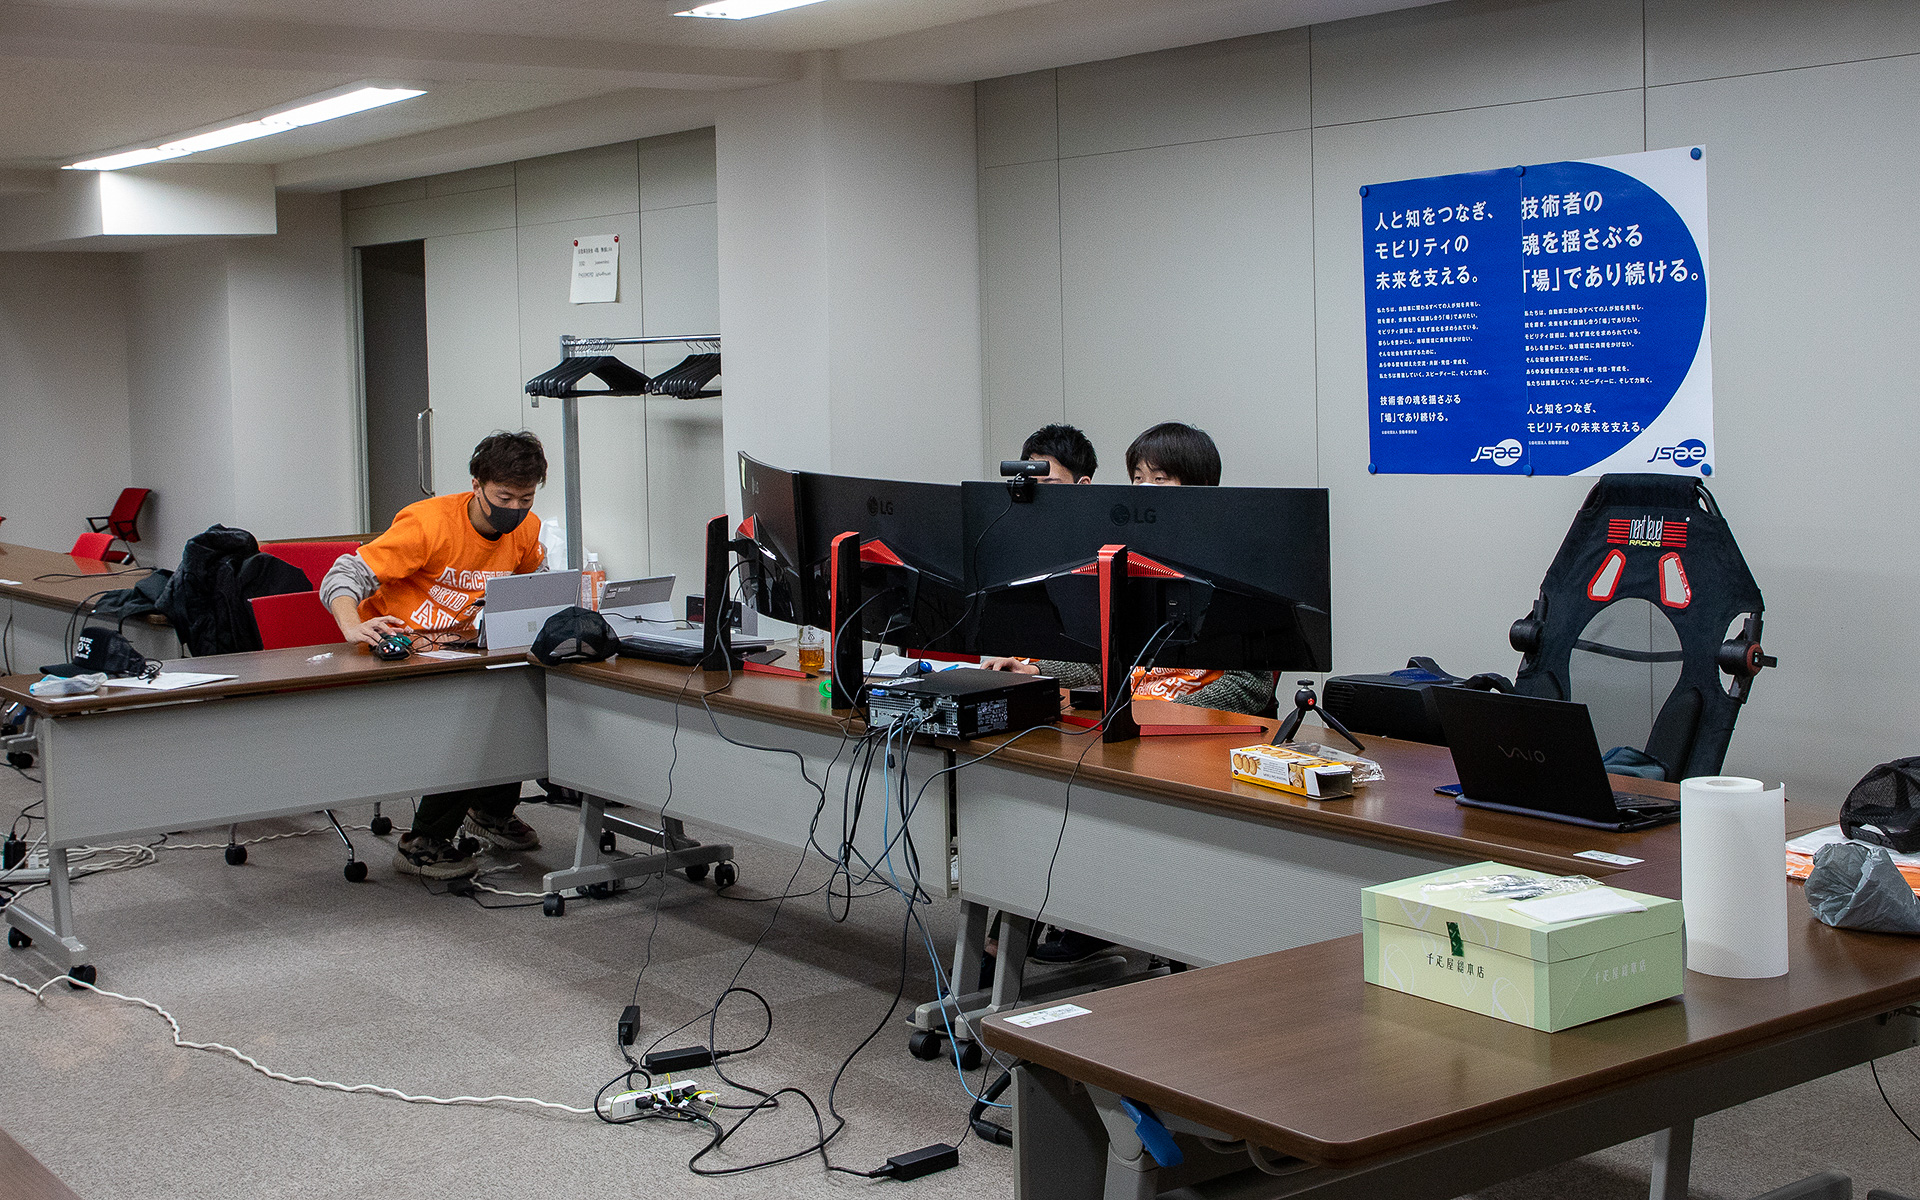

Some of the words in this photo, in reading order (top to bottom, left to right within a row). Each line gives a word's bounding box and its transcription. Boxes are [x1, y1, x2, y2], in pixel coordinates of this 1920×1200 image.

[1521, 190, 1603, 220] 技術者の
[1375, 201, 1493, 231] 人と知をつなぎ、
[1375, 235, 1469, 260] モビリティの
[1522, 223, 1643, 256] 魂を揺さぶる
[1376, 265, 1478, 290] 未来を支える。
[1523, 258, 1699, 293] 「場」であり続ける。
[1380, 394, 1461, 406] 技術者の魂を揺さぶる
[1527, 402, 1597, 415] 人と知をつなぎ、
[1380, 412, 1449, 423] 「場」であり続ける。
[1527, 421, 1645, 433] モビリティの未来を支える。
[880, 500, 894, 515] LG
[1133, 508, 1157, 523] LG
[428, 585, 469, 612] SKID
[1497, 745, 1546, 763] VAIO
